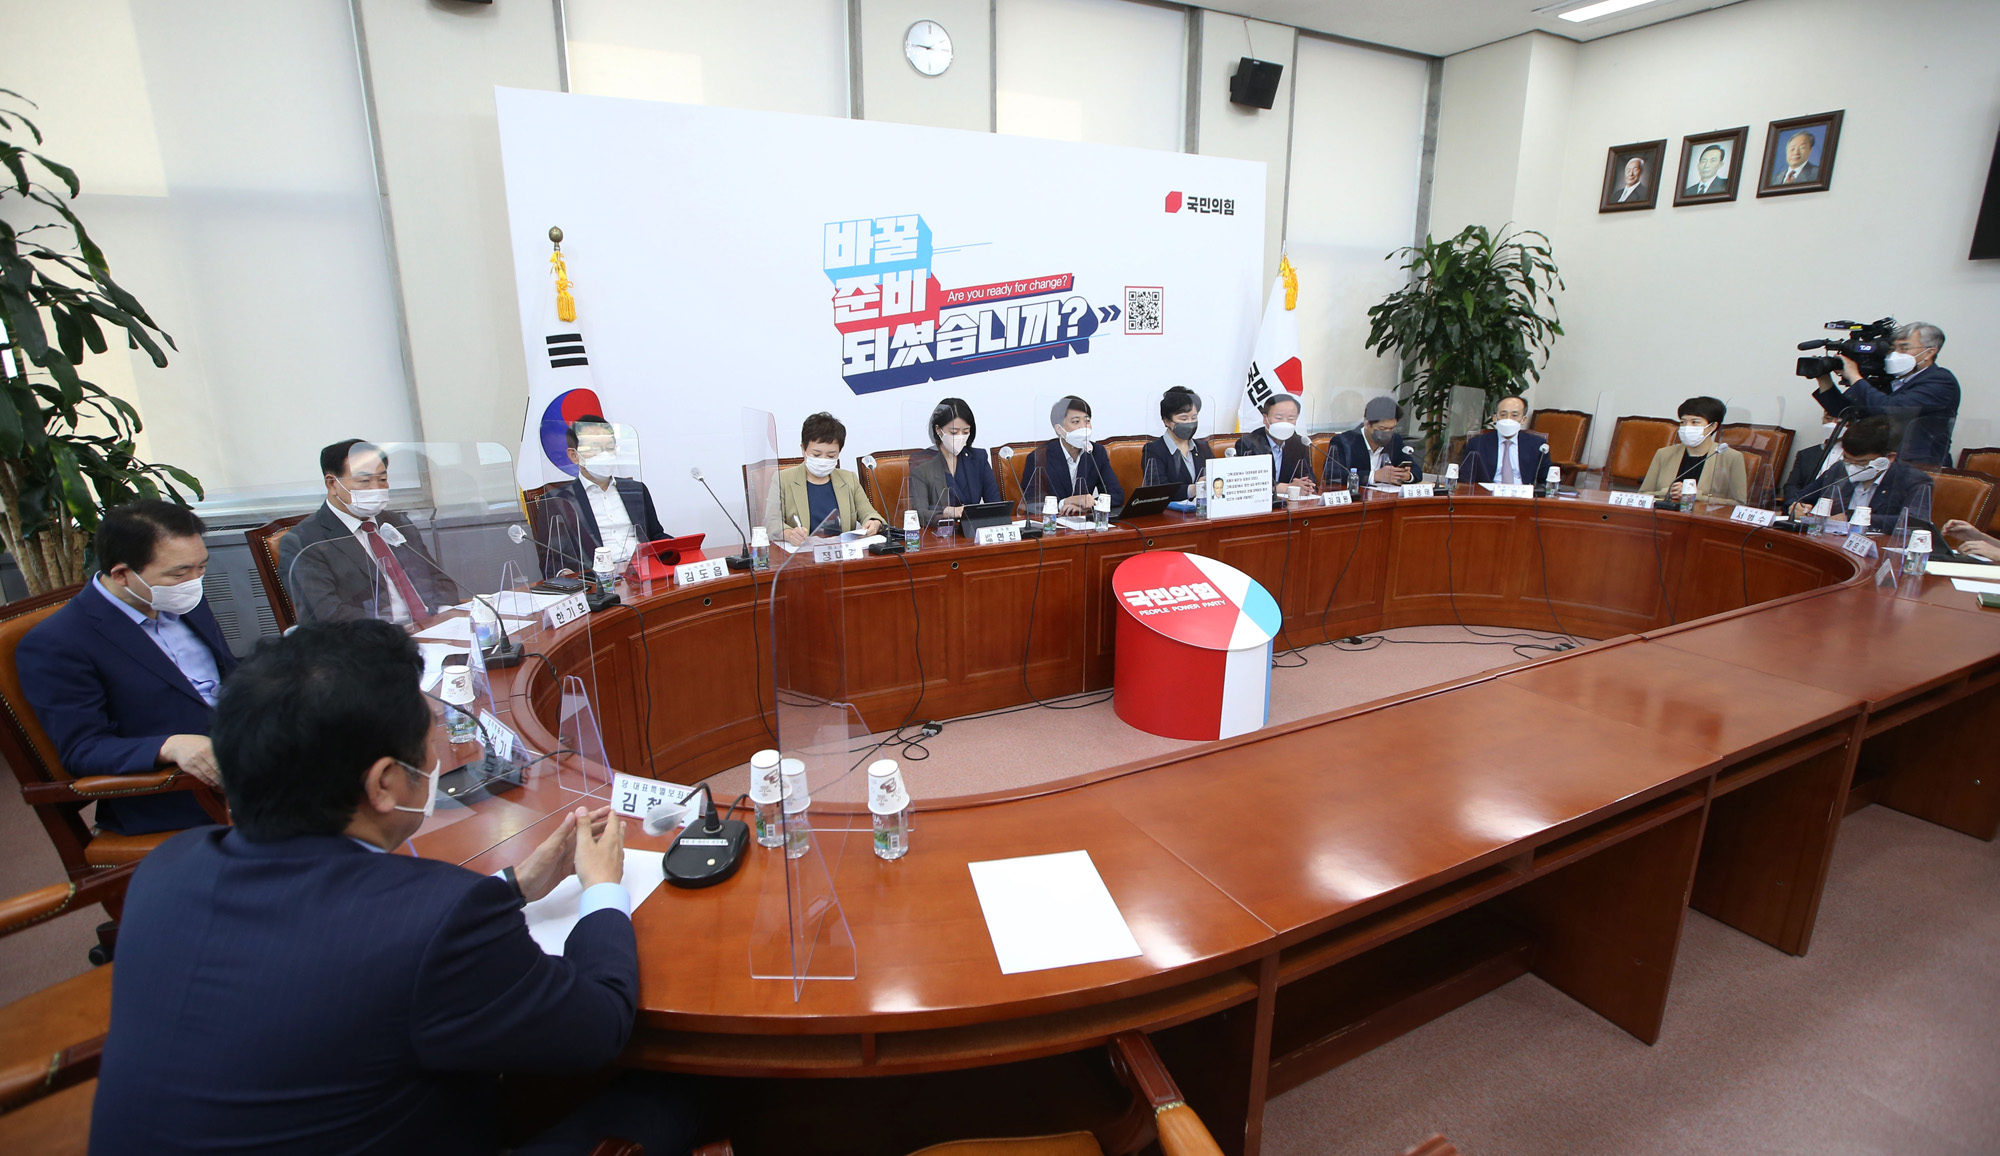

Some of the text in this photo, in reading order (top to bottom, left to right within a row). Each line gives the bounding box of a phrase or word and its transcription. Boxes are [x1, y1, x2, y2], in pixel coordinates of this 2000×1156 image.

[1186, 196, 1235, 216] 국민의힘
[823, 214, 920, 270] 바꿀
[833, 268, 928, 324] 준비
[947, 275, 1069, 302] Are you ready for change?
[842, 296, 1088, 378] 되셨습니까?
[684, 566, 723, 582] 김도읍
[1122, 582, 1222, 607] 국민의힘
[555, 602, 586, 624] 한기호
[1138, 599, 1227, 616] PEOPLE POWER PARTY
